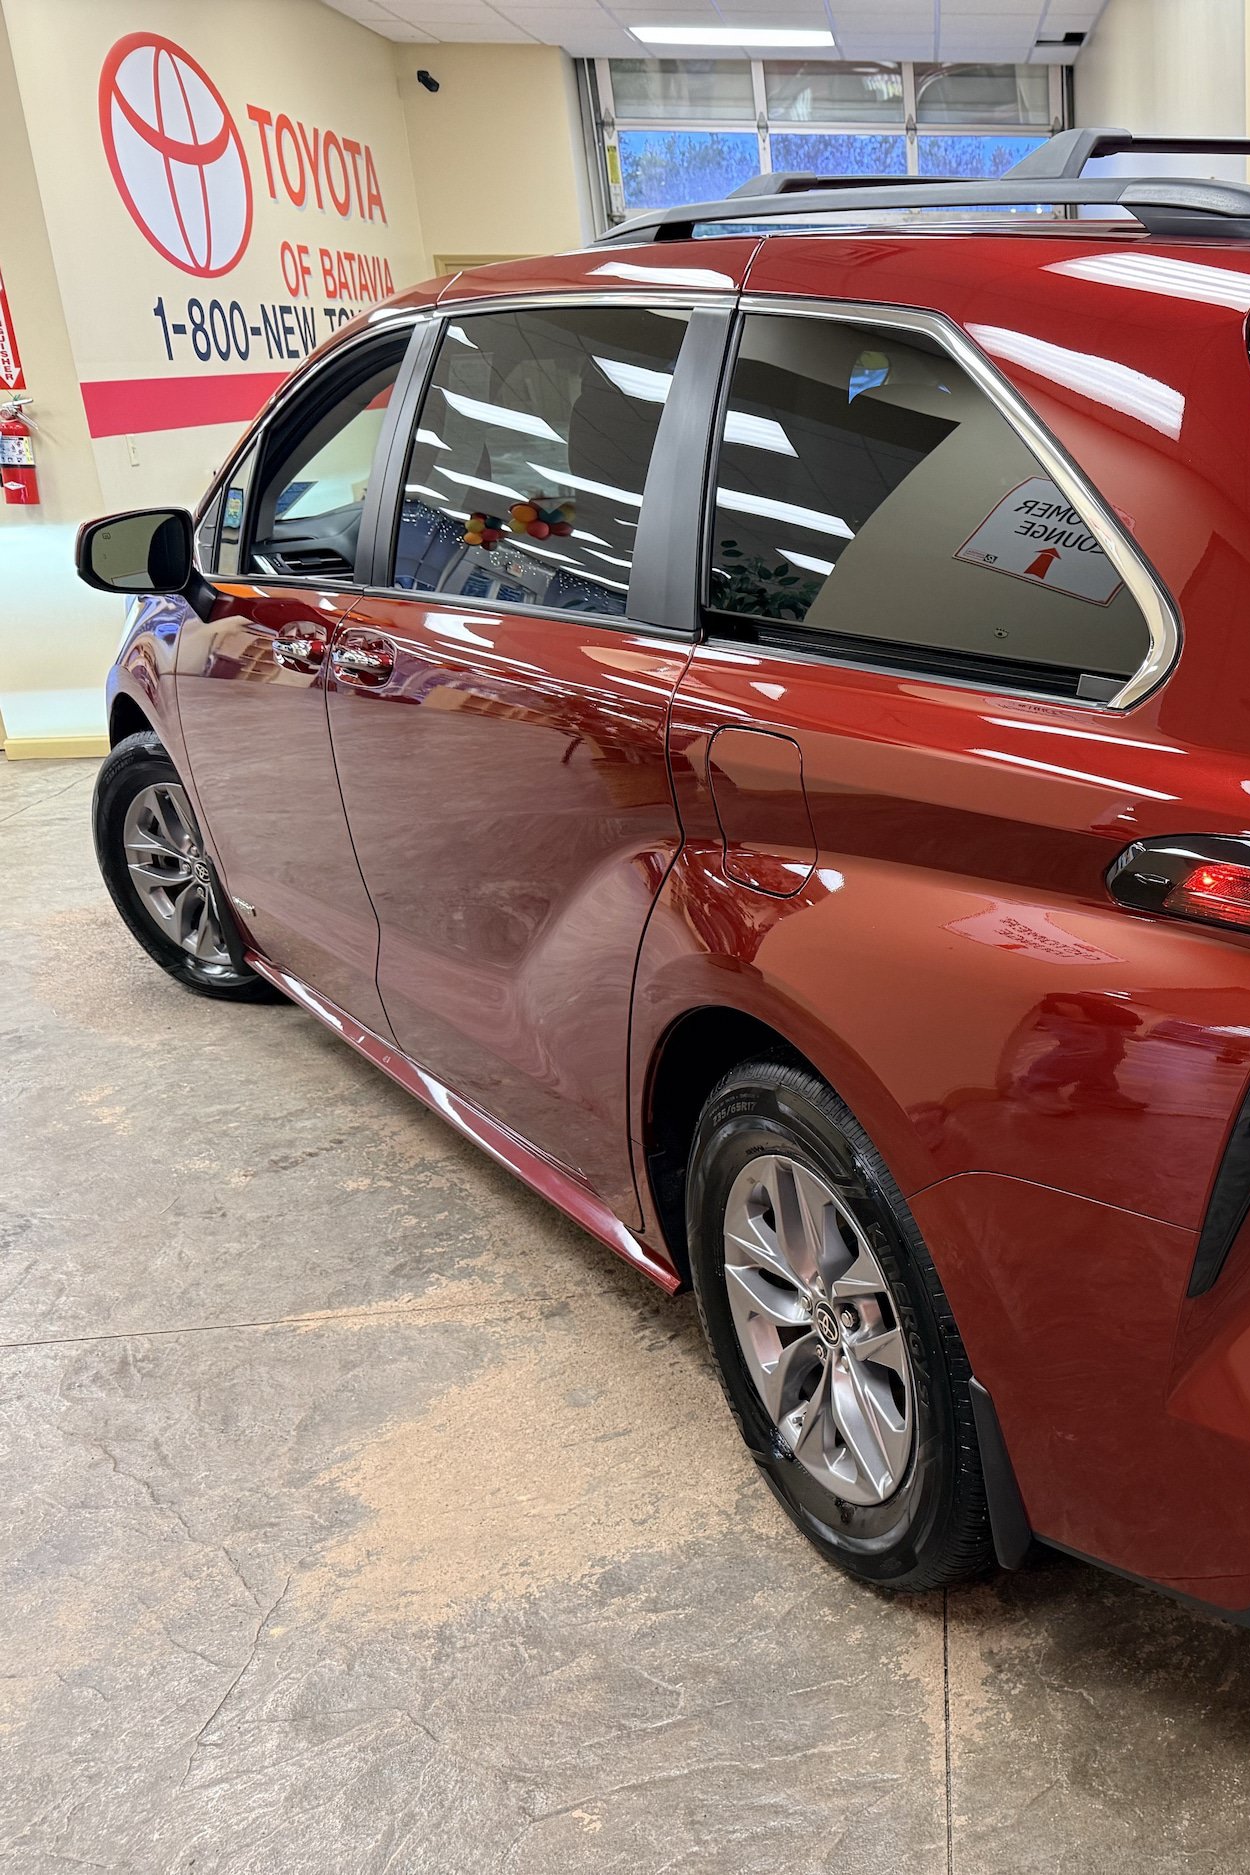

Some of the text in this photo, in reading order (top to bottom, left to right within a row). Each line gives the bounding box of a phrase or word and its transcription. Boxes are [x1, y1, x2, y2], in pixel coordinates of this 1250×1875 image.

[246, 104, 388, 224] TOYOTA
[280, 241, 395, 300] OF BATAVIA
[153, 296, 317, 362] 1-800-NEW
